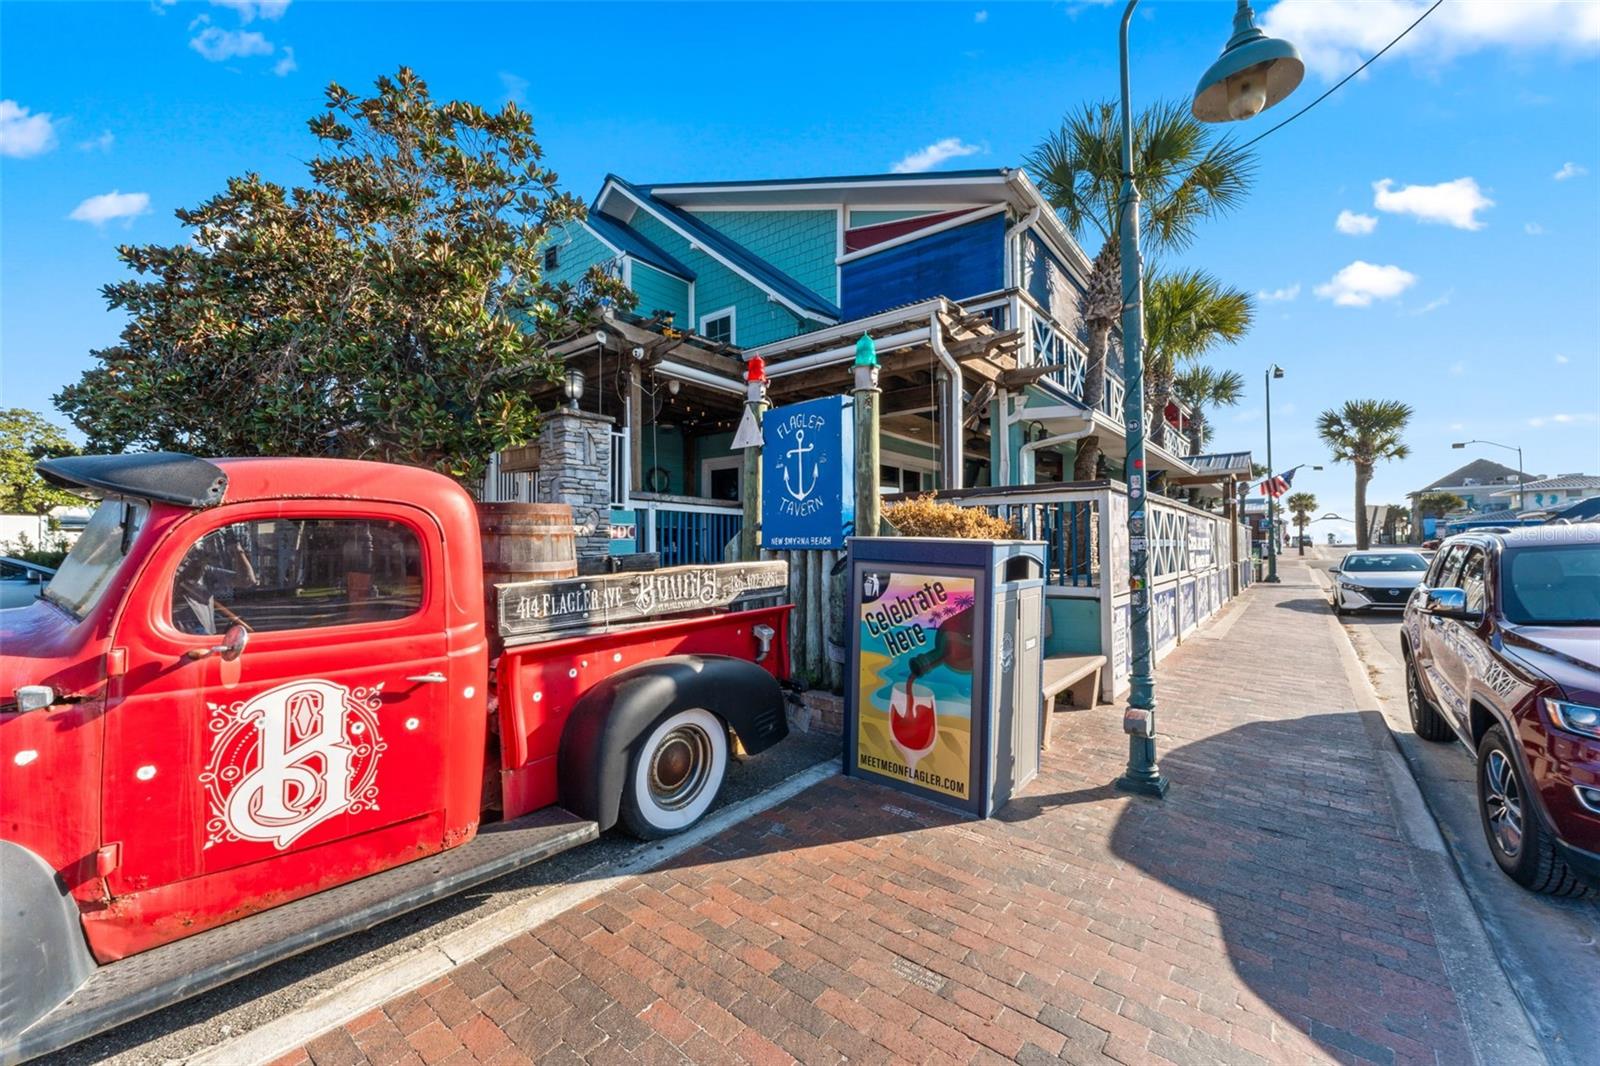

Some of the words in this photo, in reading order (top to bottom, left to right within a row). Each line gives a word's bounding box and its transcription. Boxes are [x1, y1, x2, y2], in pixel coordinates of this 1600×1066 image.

[777, 414, 825, 439] FLAGLER
[780, 496, 824, 517] TAVERN
[770, 537, 783, 546] NEW
[810, 536, 832, 546] BEACH
[542, 588, 600, 617] FLAGLER
[865, 581, 948, 637] Celebrate
[883, 623, 927, 657] Here
[860, 754, 965, 794] MEETMEONFLAGLER.COM
